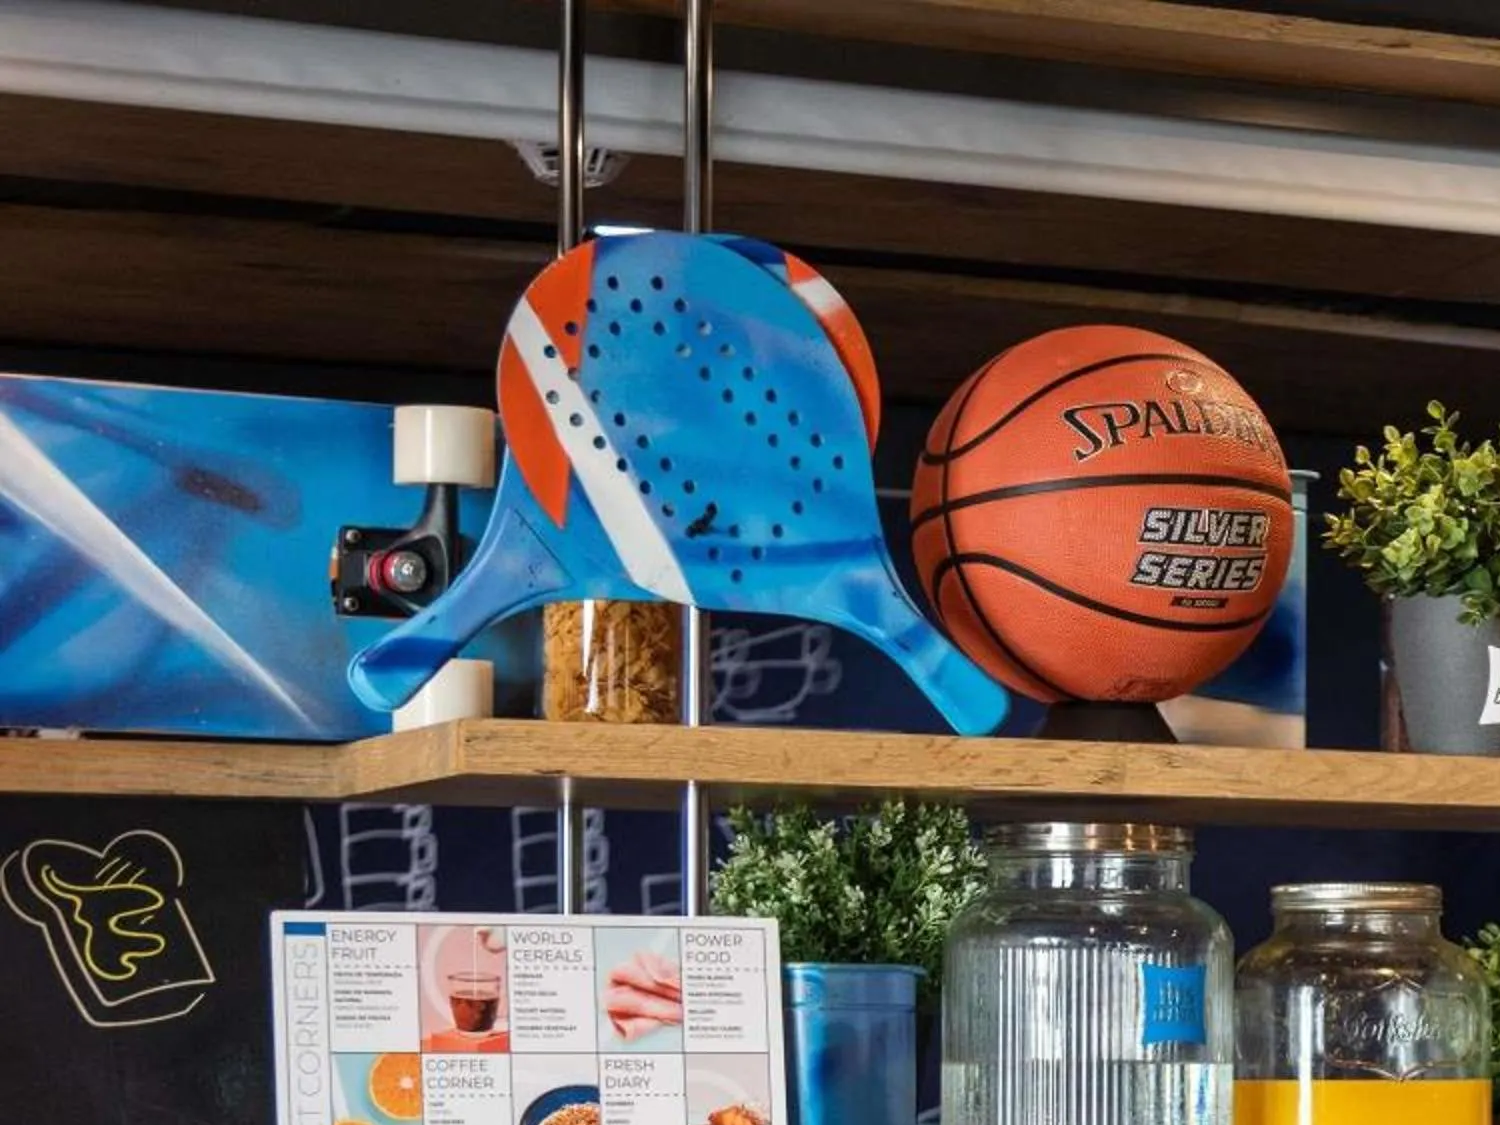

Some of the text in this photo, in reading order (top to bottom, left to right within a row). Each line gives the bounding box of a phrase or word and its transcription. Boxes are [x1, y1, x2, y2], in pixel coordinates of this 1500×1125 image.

[1139, 508, 1267, 546] SILVER
[1131, 552, 1264, 590] SERIES
[331, 929, 397, 943] ENERGY
[511, 931, 574, 945] WORLD
[685, 933, 743, 947] POWER
[331, 947, 377, 960] FRUIT
[513, 949, 583, 963] CEREALS
[686, 951, 731, 963] FOOD
[293, 943, 322, 1098] CORNERS
[426, 1059, 489, 1073] COFFEE
[604, 1059, 655, 1072] FRESH
[427, 1076, 495, 1090] CORNER
[605, 1076, 651, 1089] DIARY
